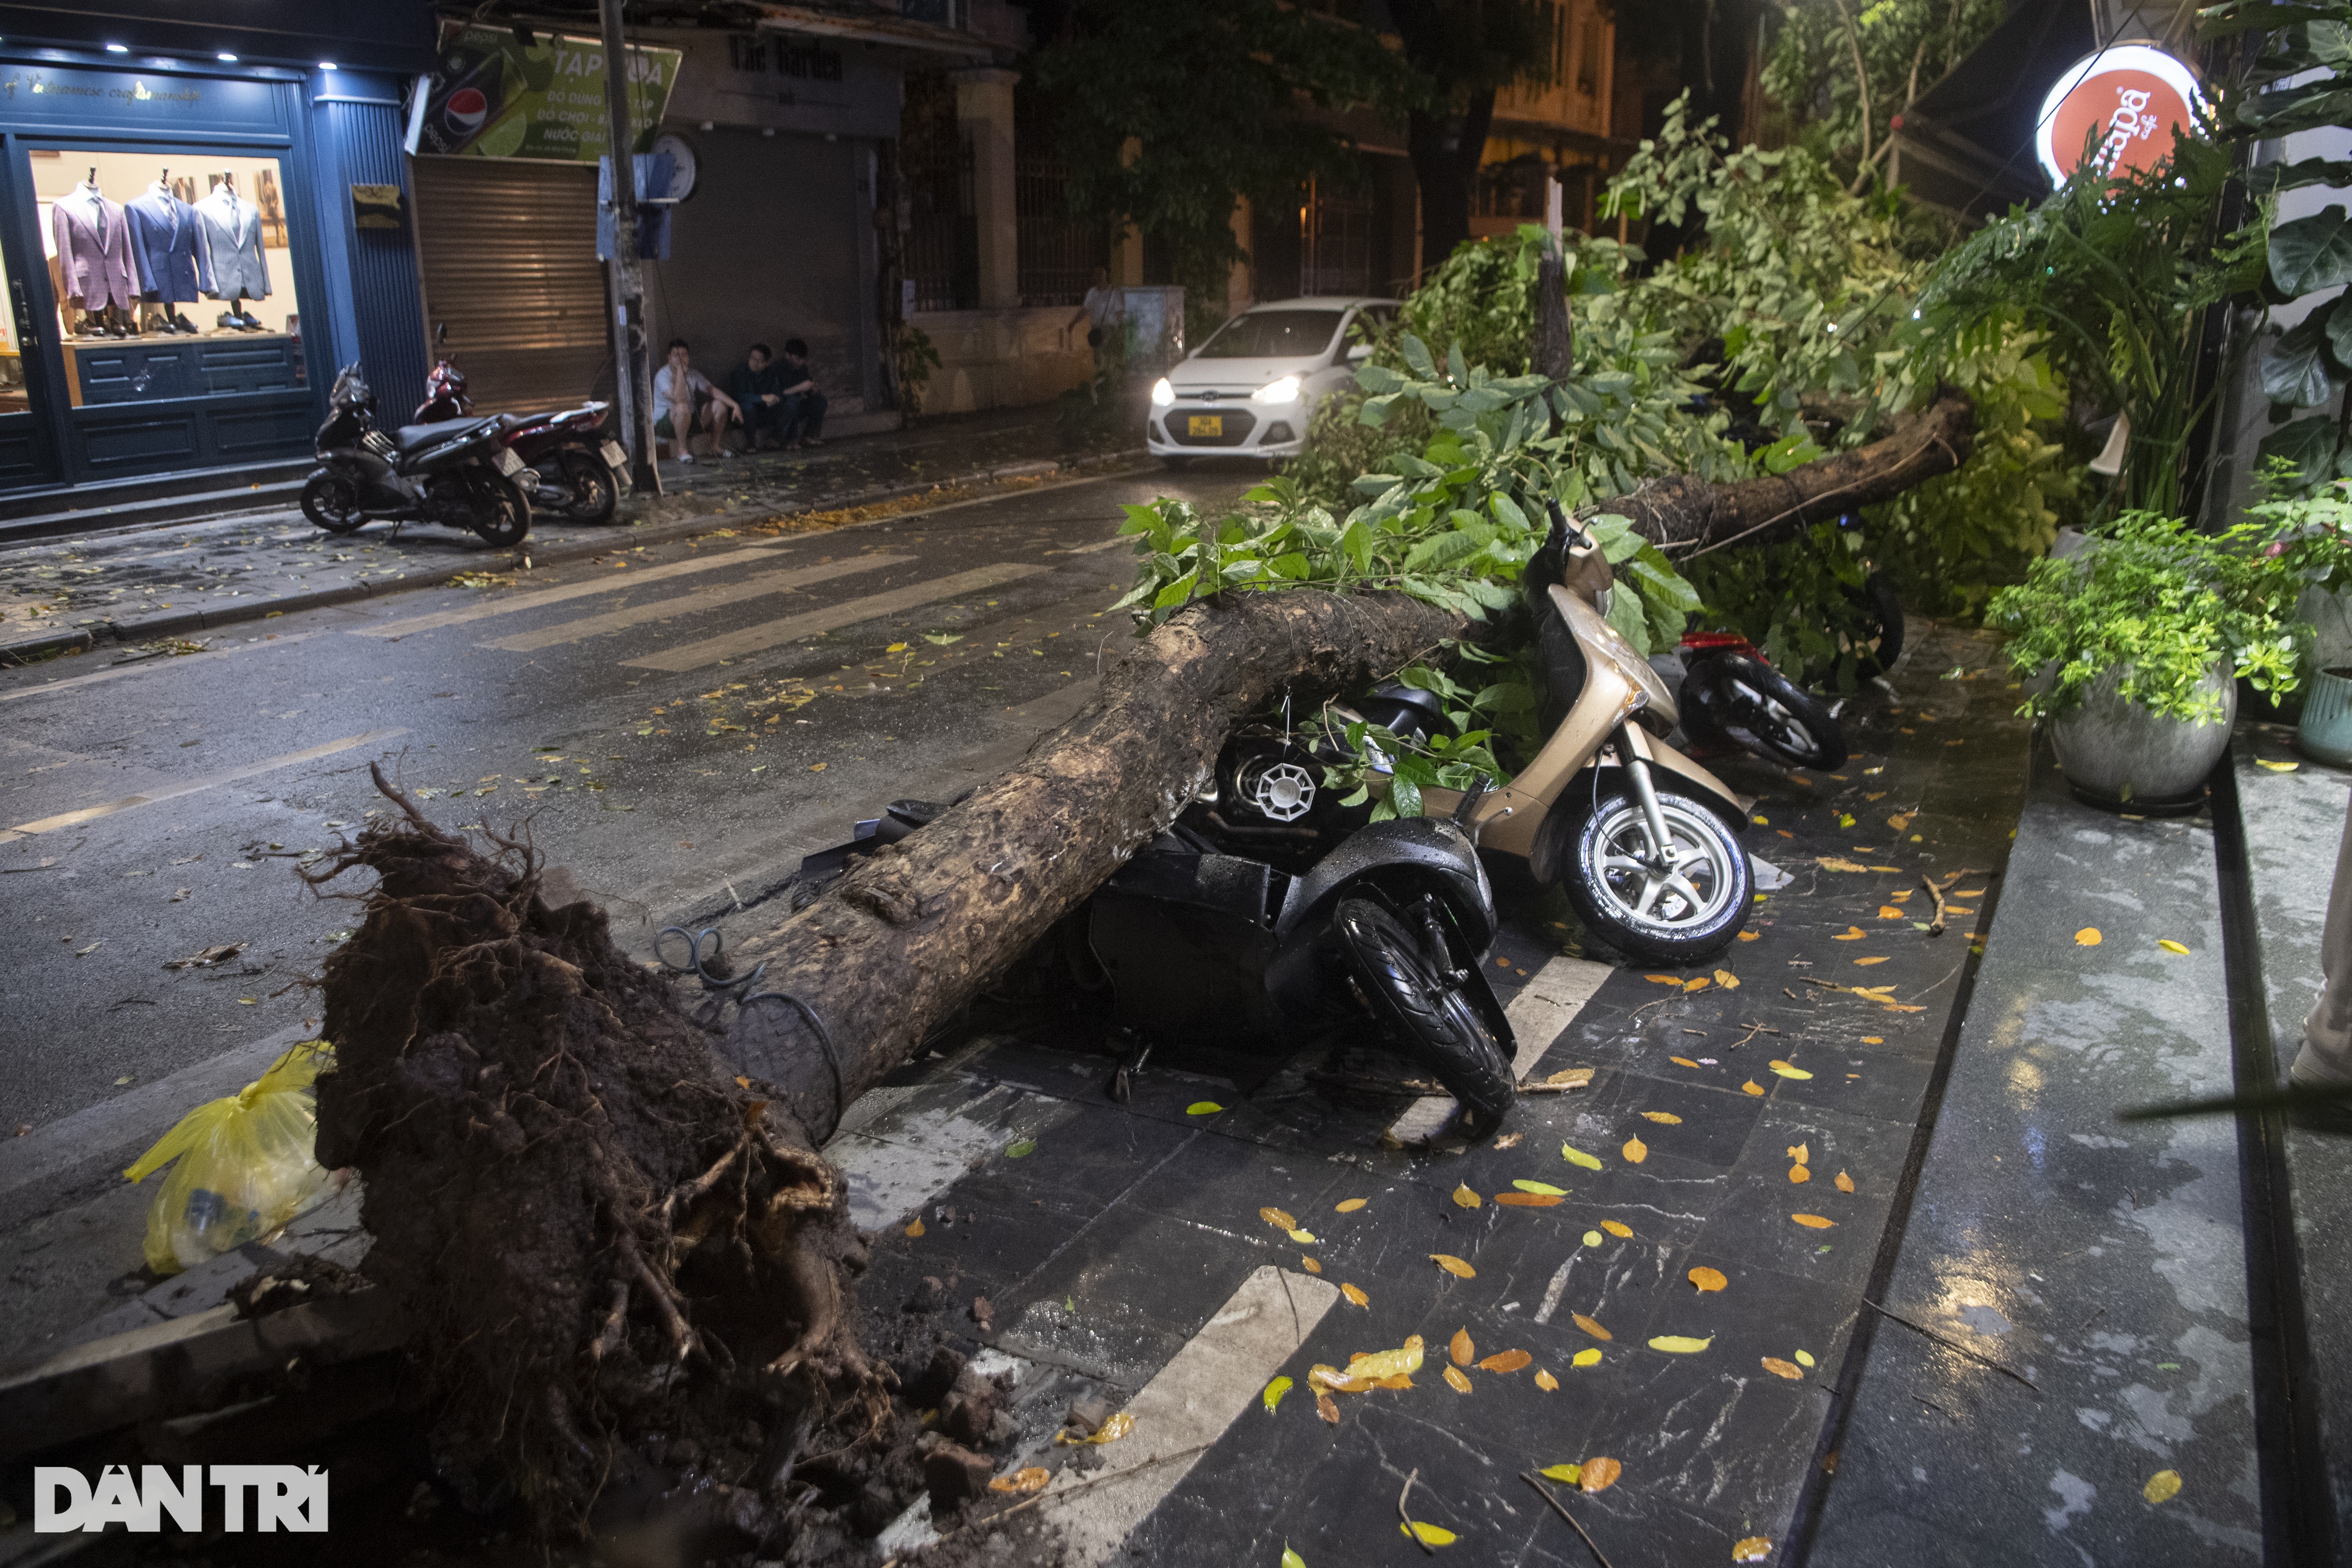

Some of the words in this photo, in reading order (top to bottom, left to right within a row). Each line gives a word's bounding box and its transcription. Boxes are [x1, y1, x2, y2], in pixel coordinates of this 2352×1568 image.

[465, 31, 498, 43] pepsi
[555, 50, 603, 82] TẠP
[568, 91, 602, 107] DÙNG
[425, 123, 451, 153] pepsi
